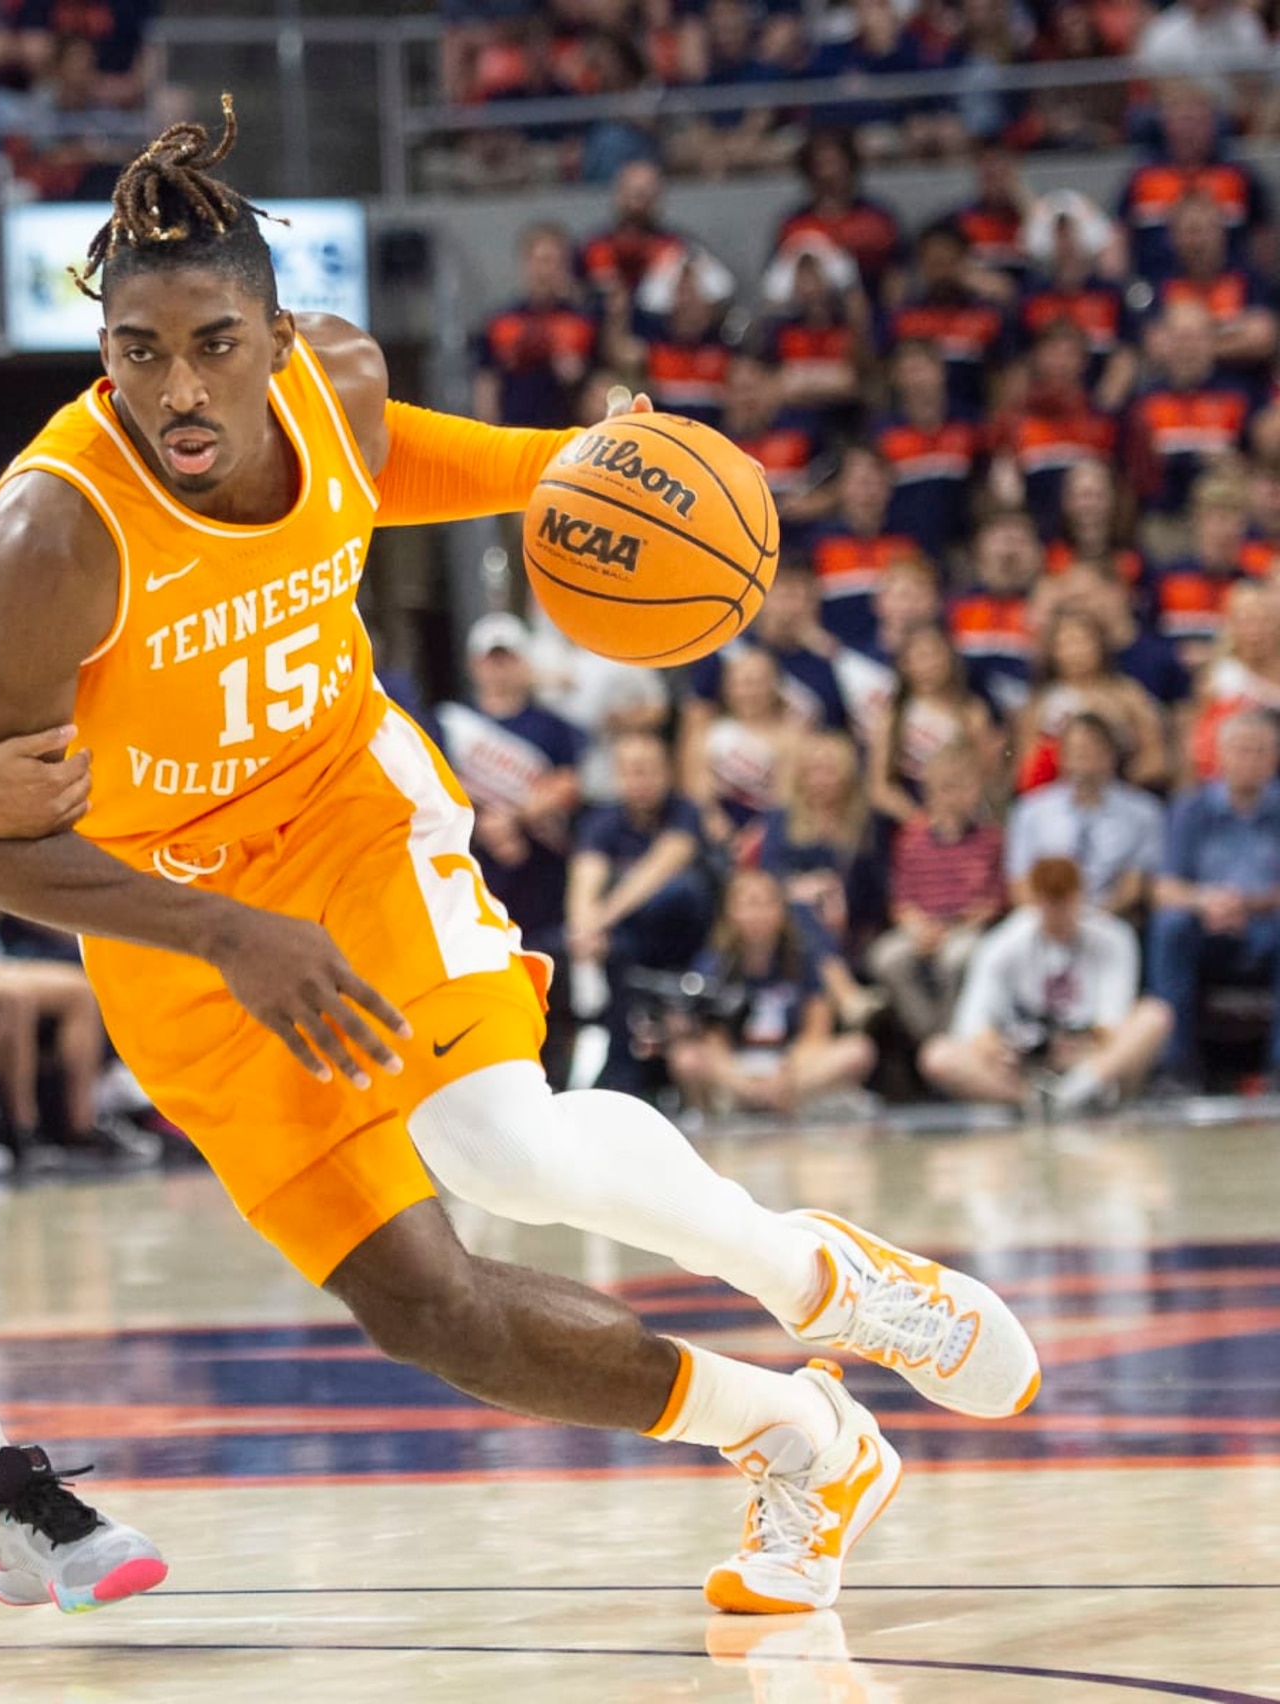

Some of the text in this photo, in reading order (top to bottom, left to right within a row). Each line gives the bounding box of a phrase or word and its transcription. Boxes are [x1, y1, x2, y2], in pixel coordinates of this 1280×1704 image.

[559, 434, 698, 518] Wilson
[537, 506, 641, 574] NCAA
[144, 535, 364, 671] TENNESSEE
[217, 621, 321, 748] 15
